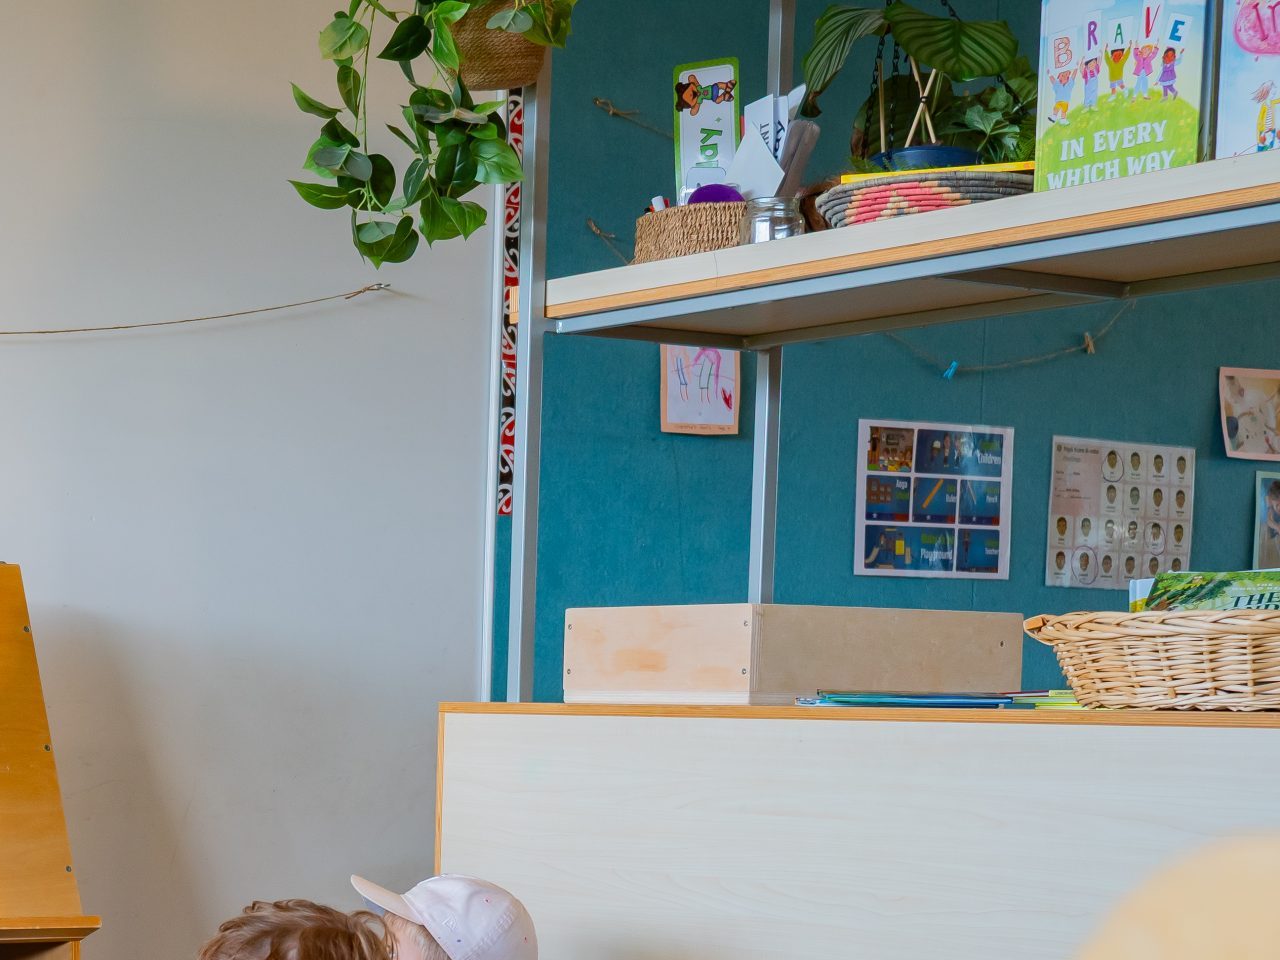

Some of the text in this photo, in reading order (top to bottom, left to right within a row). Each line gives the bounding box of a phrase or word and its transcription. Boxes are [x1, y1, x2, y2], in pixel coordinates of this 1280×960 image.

[1053, 4, 1186, 69] BRAVE
[1059, 120, 1167, 162] IN EVERY
[1046, 149, 1176, 190] WHICH WAY
